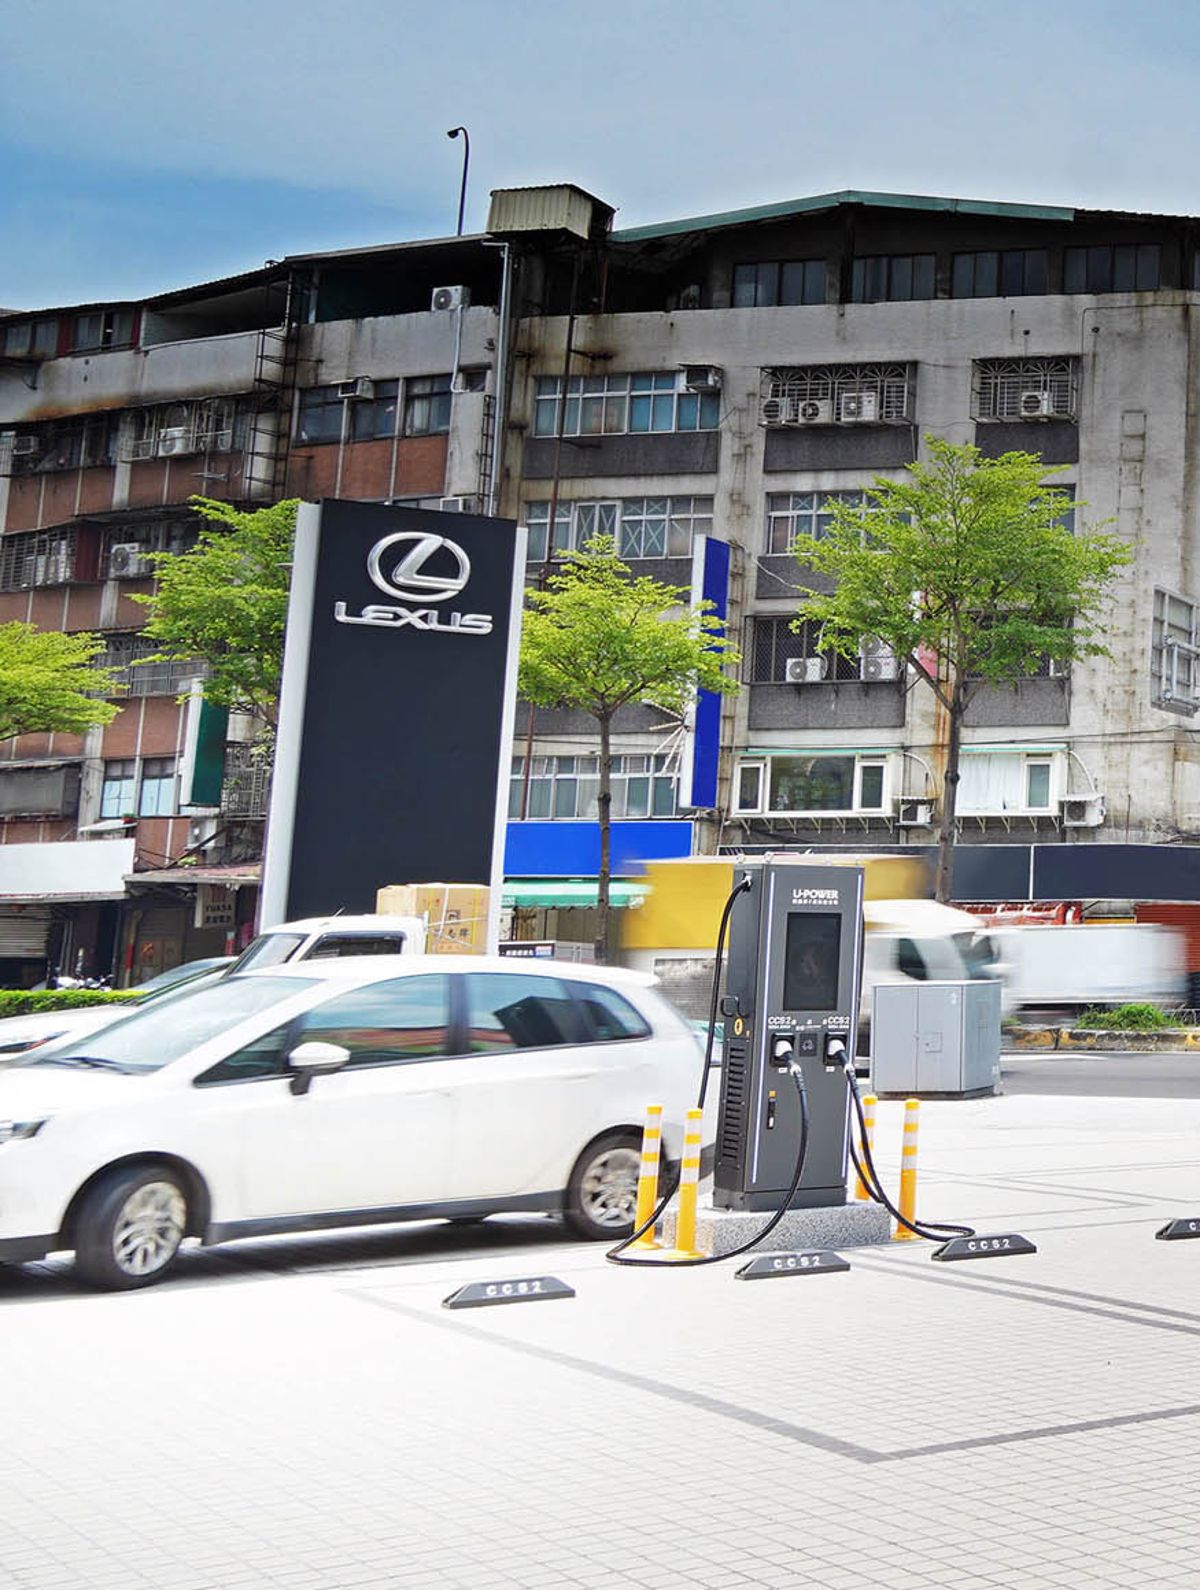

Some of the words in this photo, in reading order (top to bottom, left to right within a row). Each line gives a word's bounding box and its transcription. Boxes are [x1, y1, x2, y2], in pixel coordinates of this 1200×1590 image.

[335, 601, 493, 635] LEXUS
[792, 889, 839, 899] U-POWER
[768, 1016, 791, 1025] CCS2
[828, 1016, 850, 1025] CCS2
[967, 1238, 1010, 1251] CCS2
[773, 1255, 820, 1269] CCS2
[486, 1281, 542, 1296] CCS2
